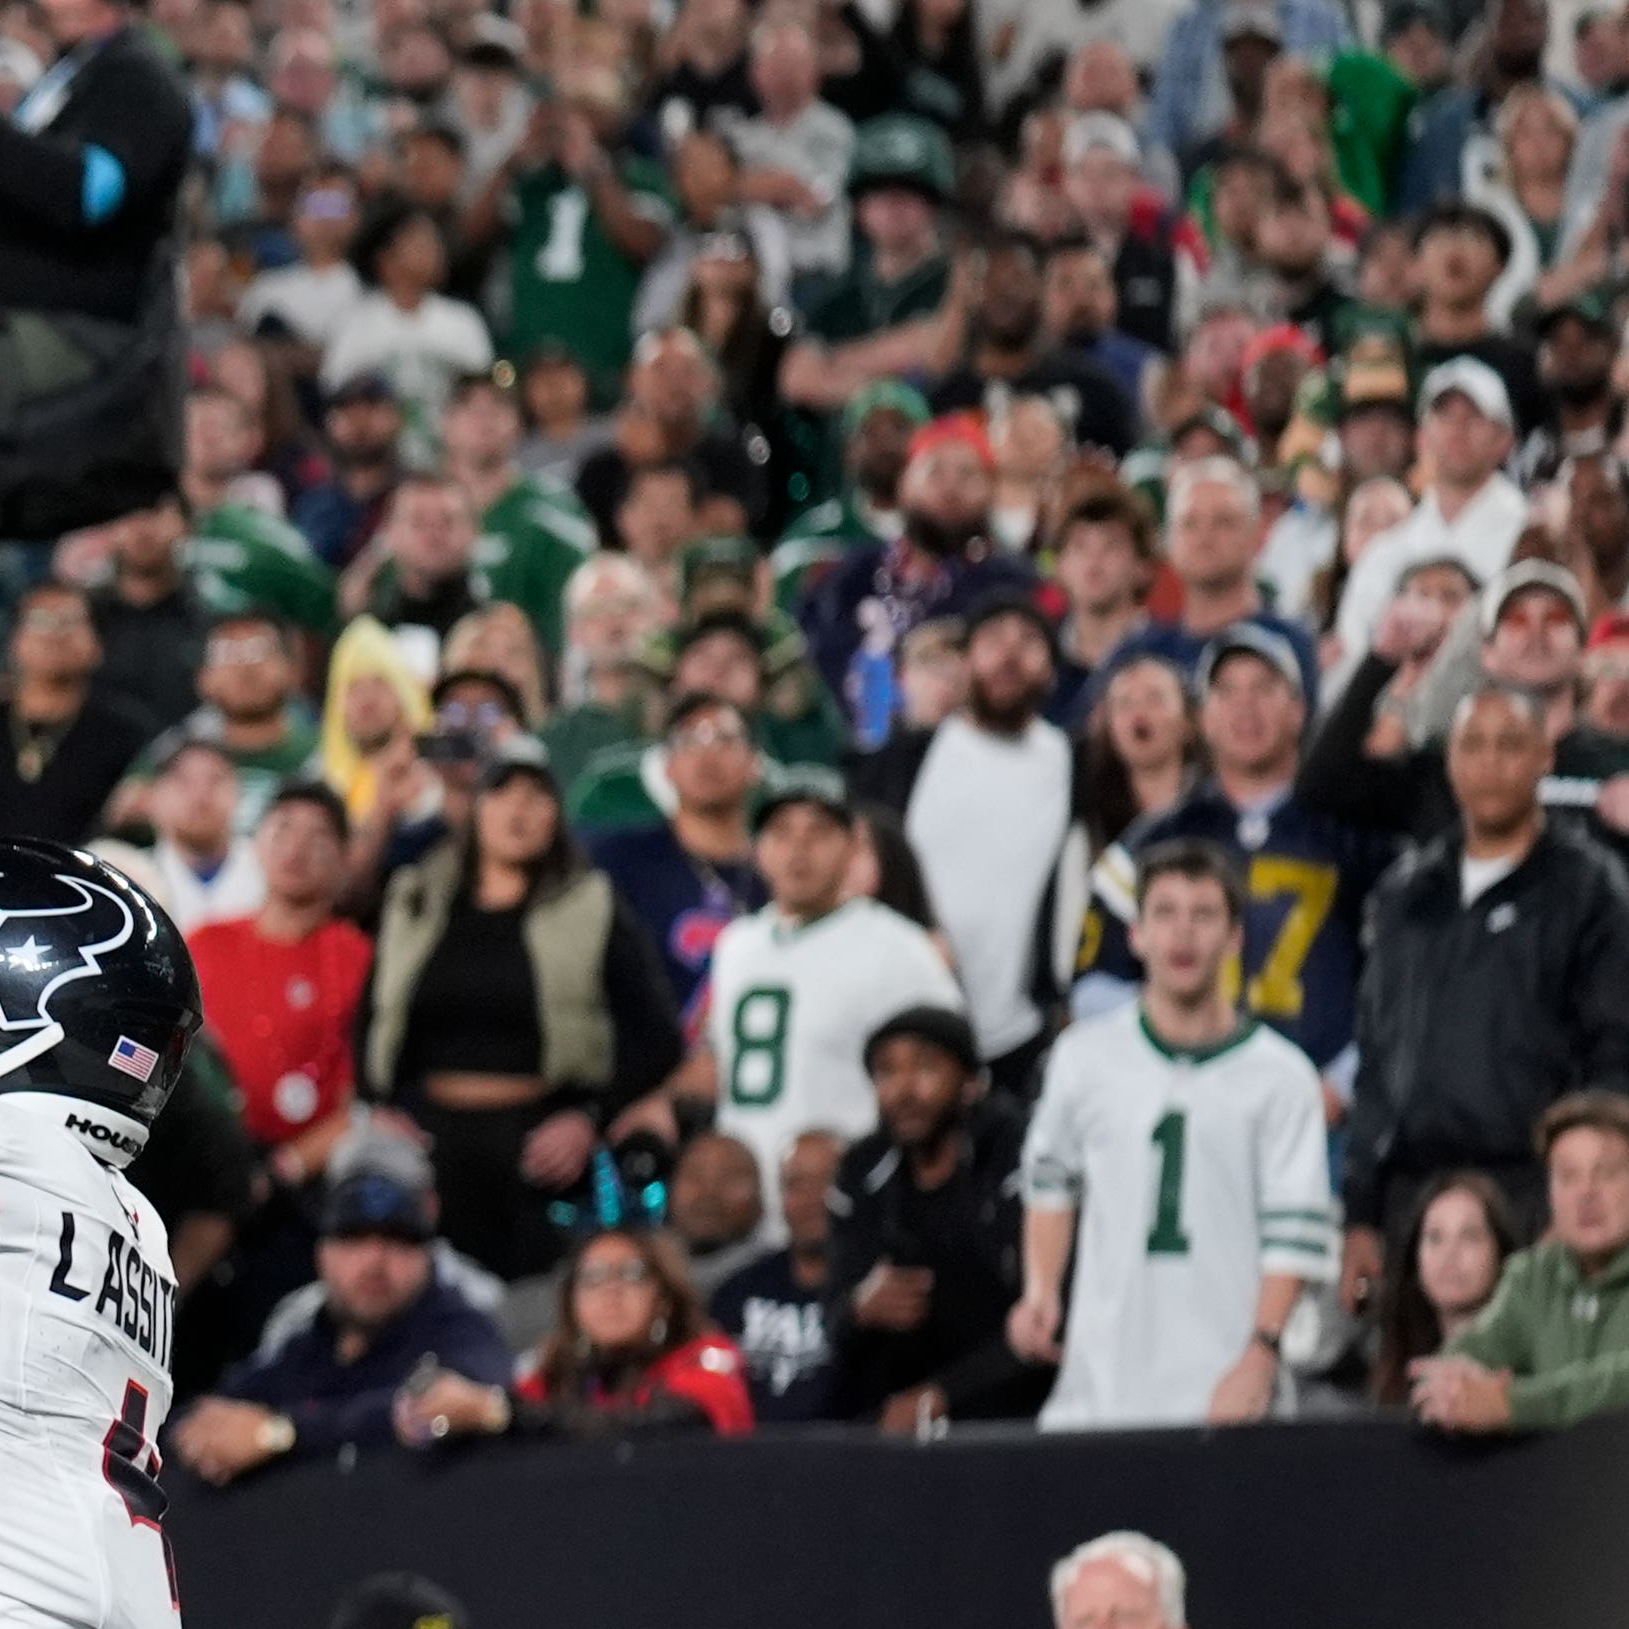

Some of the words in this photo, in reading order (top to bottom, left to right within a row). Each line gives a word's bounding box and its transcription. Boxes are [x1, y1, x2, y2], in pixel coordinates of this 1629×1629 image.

[732, 986, 790, 1105] 8
[1146, 1110, 1191, 1255] 1
[49, 1212, 173, 1373] LASSIT
